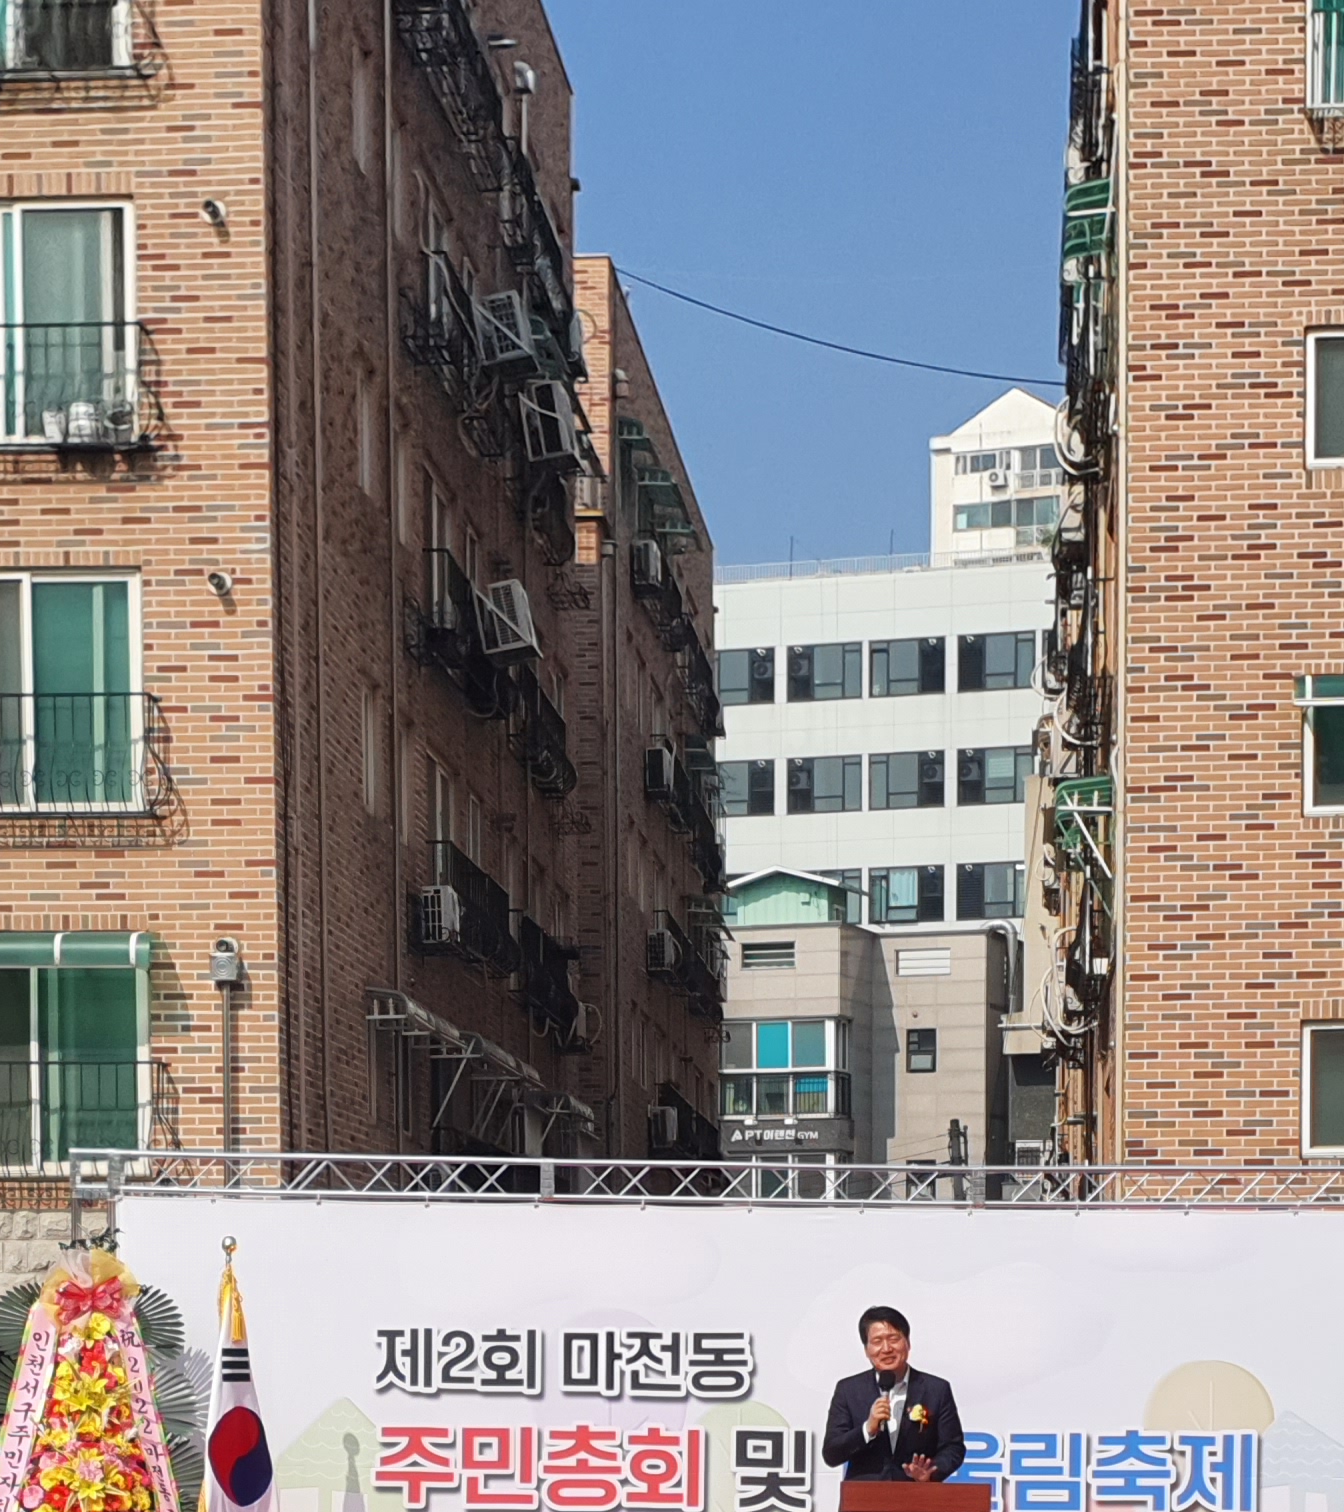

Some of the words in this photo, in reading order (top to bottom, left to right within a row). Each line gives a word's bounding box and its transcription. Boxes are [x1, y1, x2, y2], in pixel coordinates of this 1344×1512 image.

[375, 1327, 538, 1390] 제2회
[563, 1330, 753, 1393] 마전동
[375, 1425, 701, 1508] 주민총회
[735, 1429, 808, 1509] 및
